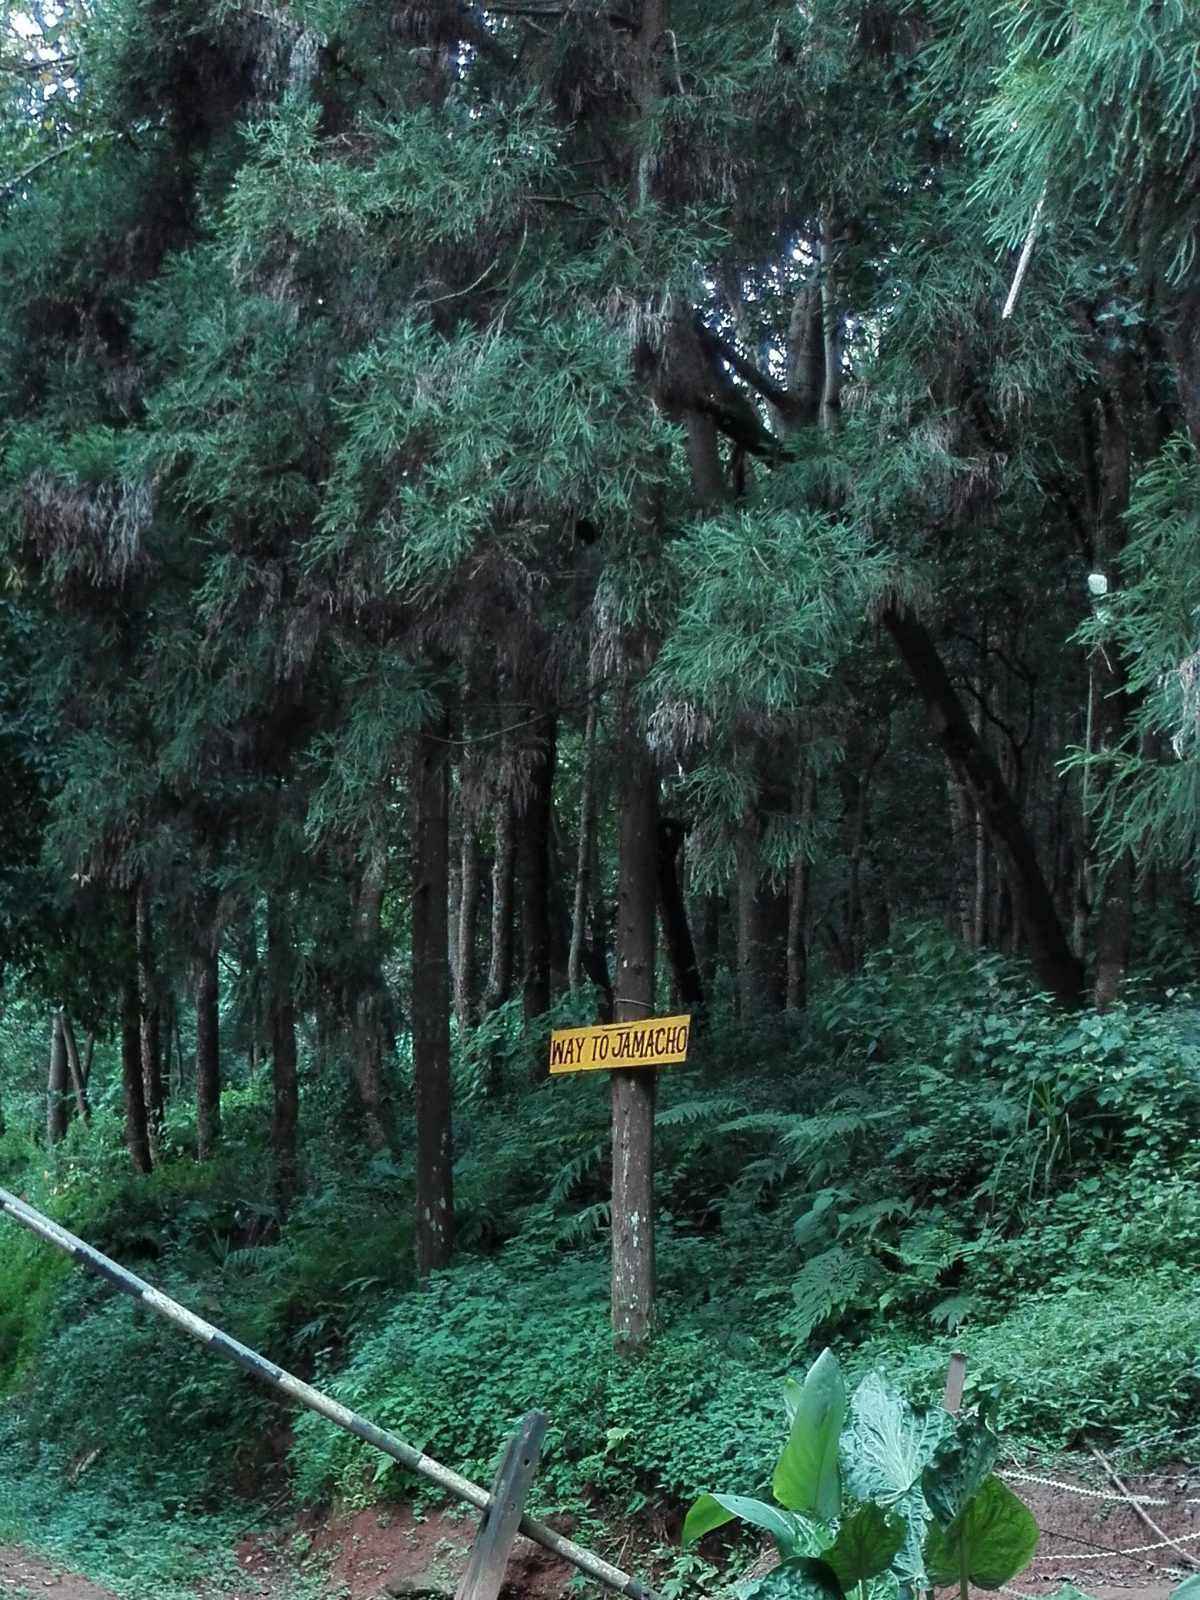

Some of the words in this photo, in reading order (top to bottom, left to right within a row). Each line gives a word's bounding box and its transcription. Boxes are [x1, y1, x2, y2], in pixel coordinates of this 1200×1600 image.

[552, 1037, 585, 1065] WAY
[592, 1034, 609, 1061] TO
[612, 1026, 687, 1058] JAMACHO
